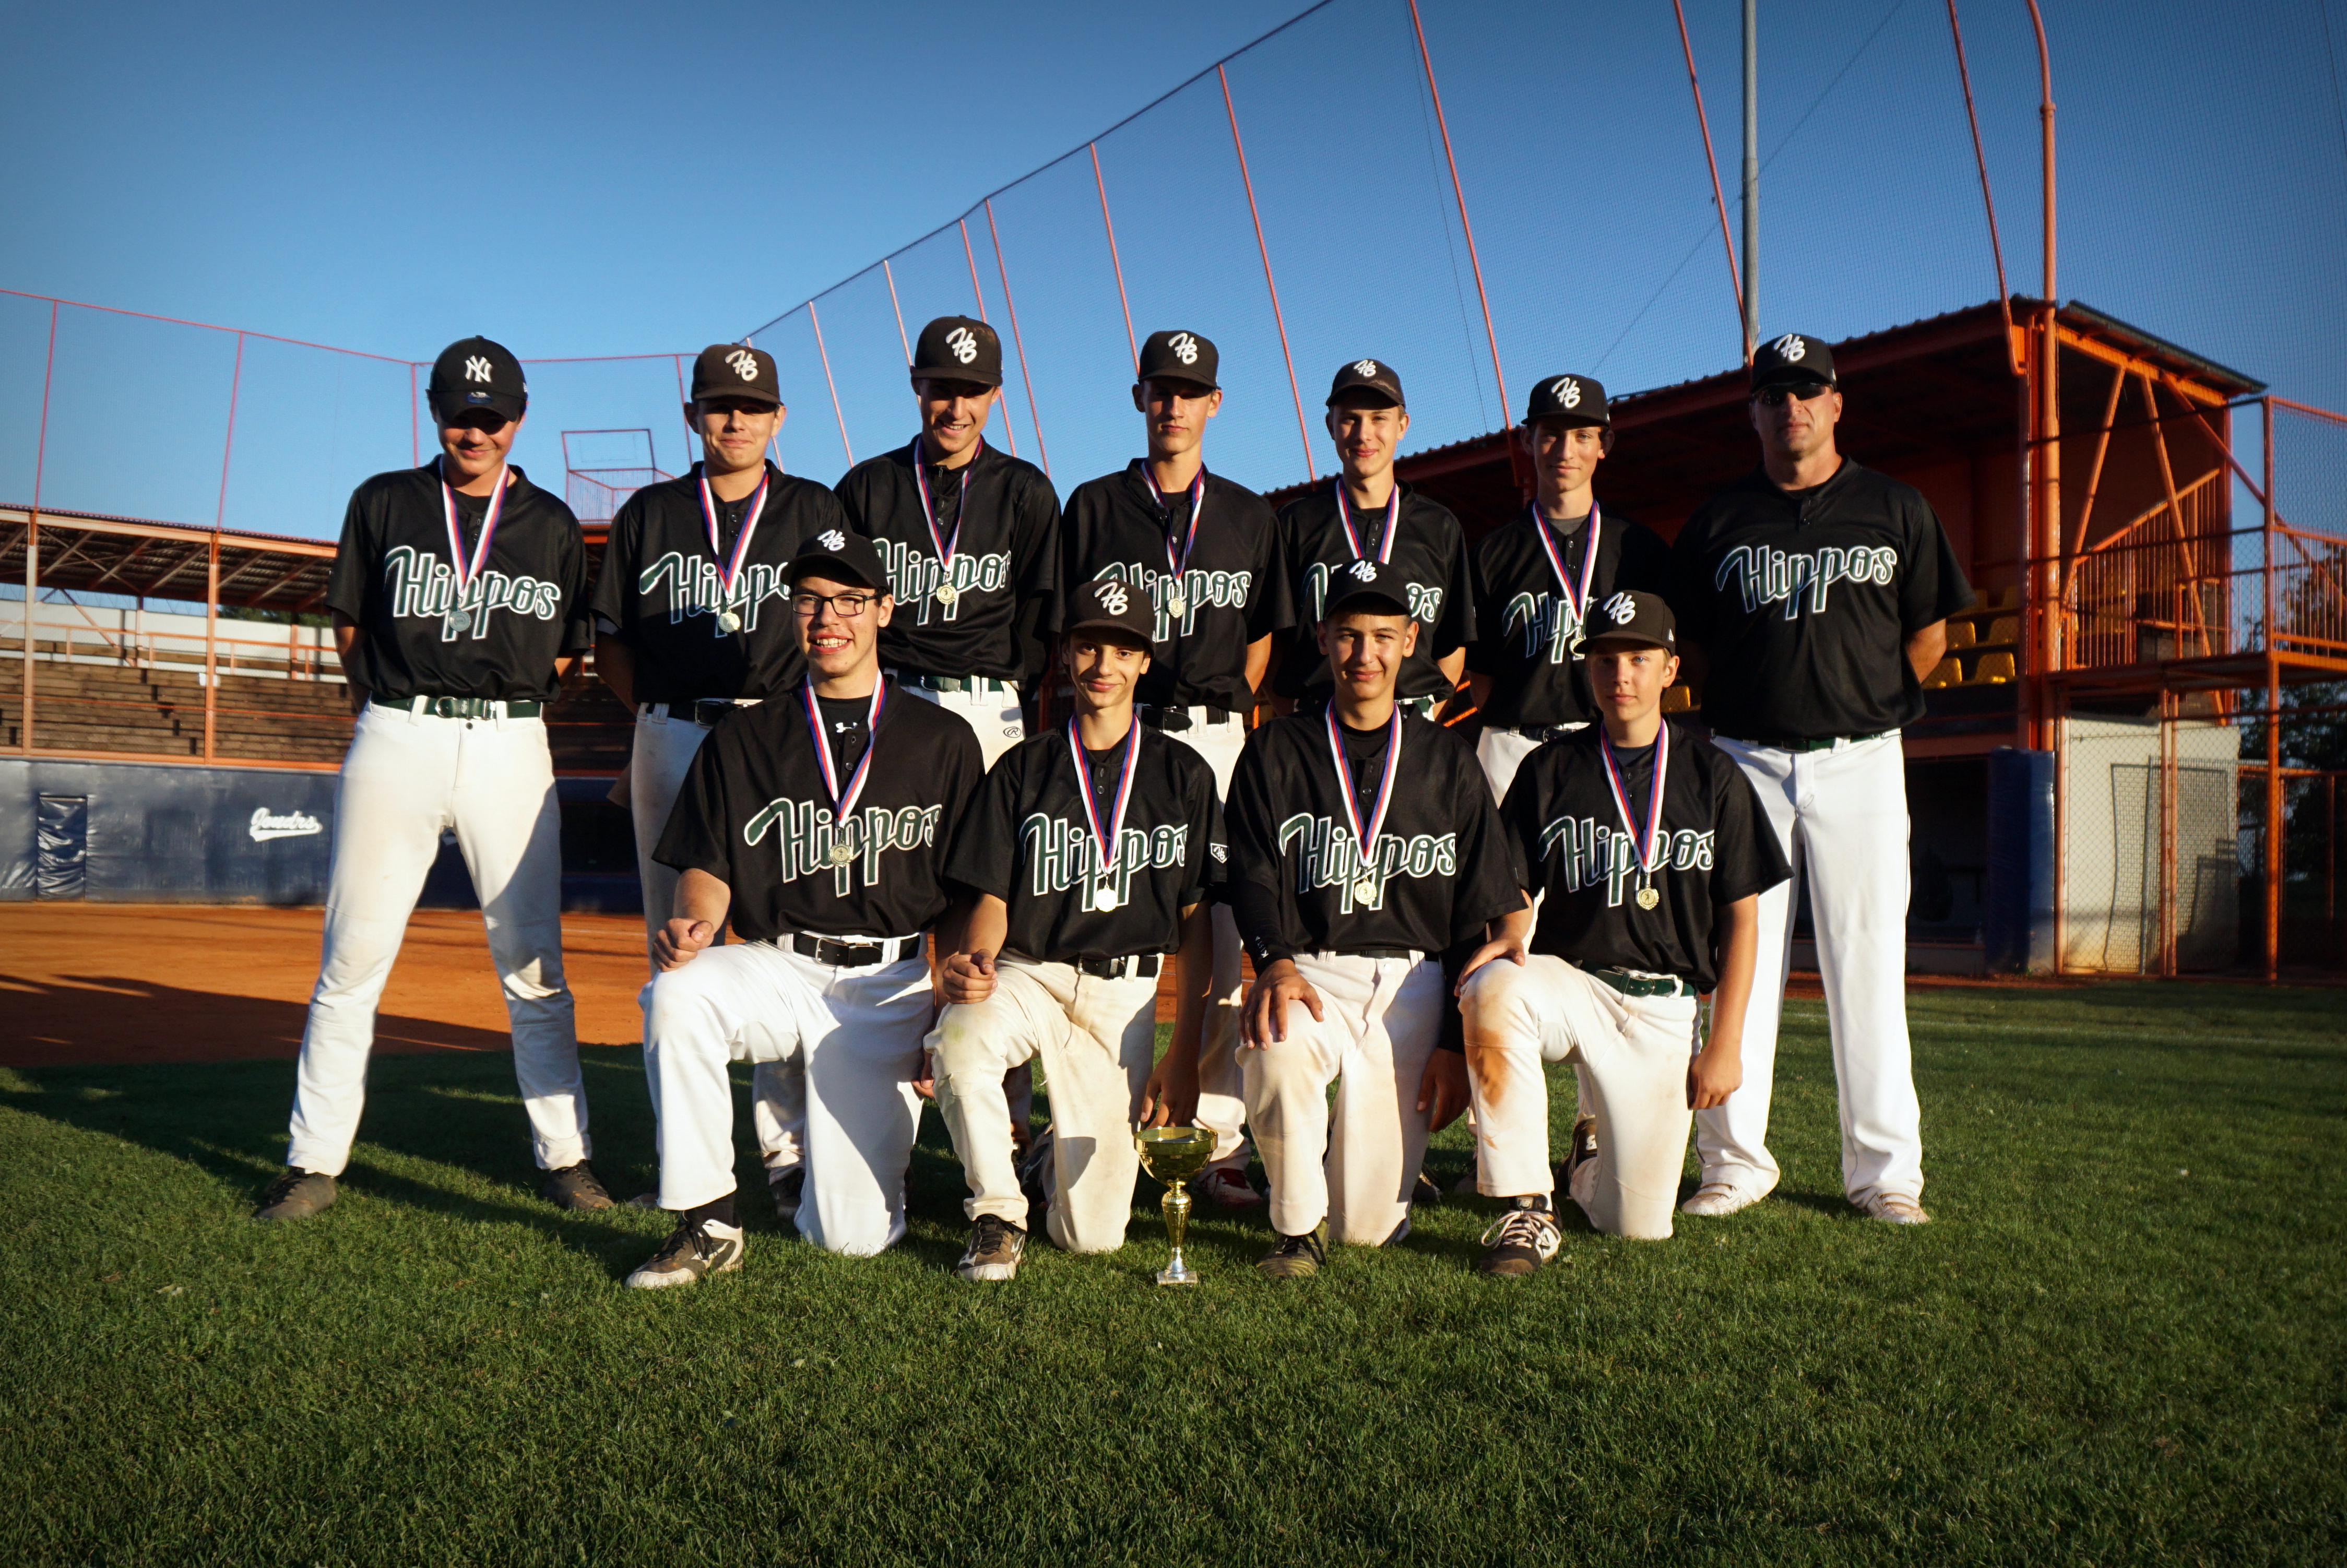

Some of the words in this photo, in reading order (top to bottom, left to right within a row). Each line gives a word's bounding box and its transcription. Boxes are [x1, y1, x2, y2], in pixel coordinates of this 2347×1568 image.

[384, 545, 561, 642] Hippos
[1716, 545, 1898, 620] Hippos
[744, 798, 942, 898] Hippos
[1019, 813, 1188, 912] Hippos
[1279, 813, 1456, 914] Hippos
[1538, 815, 1715, 907] Hippos
